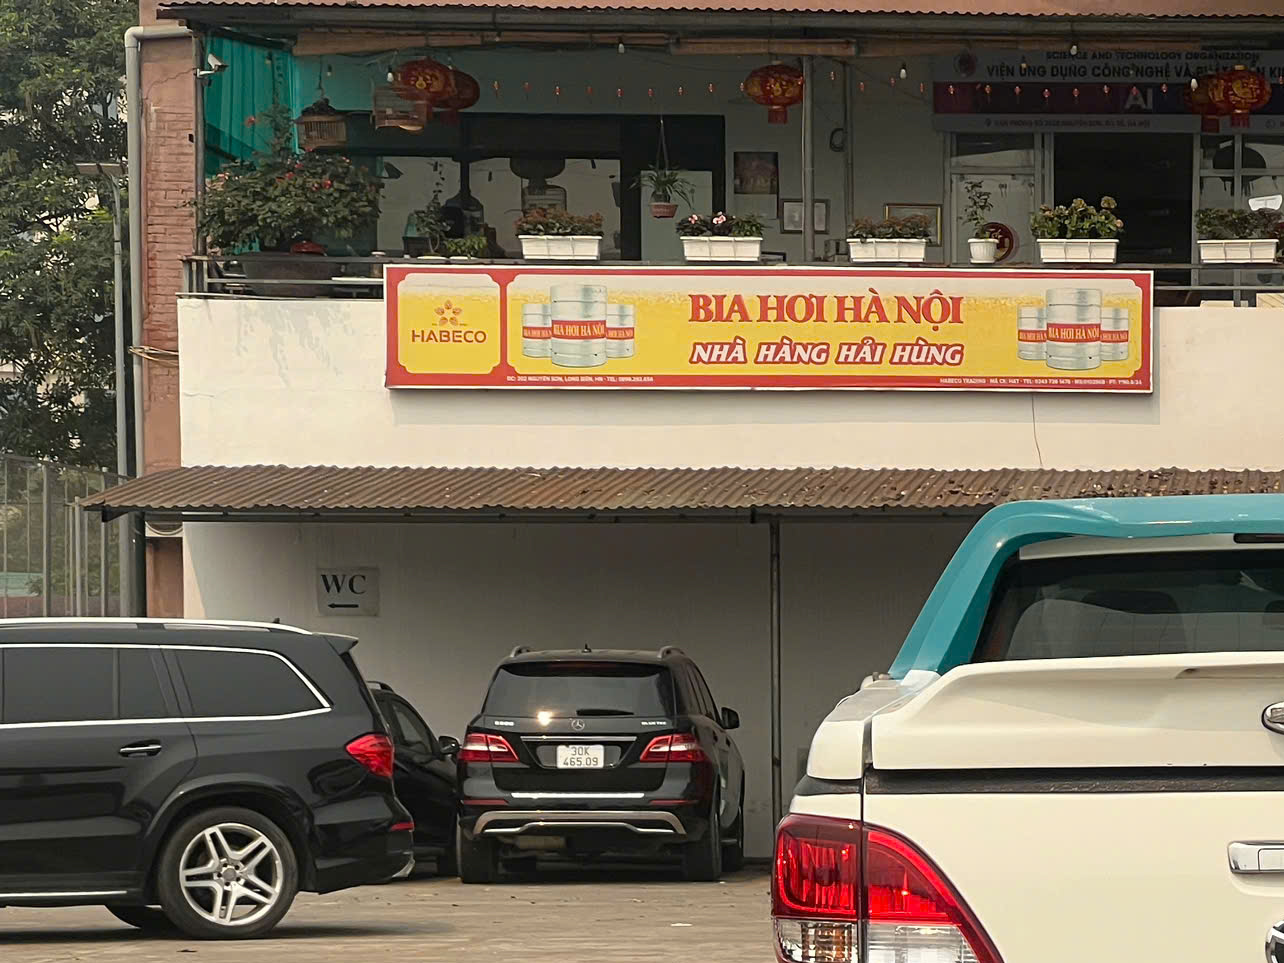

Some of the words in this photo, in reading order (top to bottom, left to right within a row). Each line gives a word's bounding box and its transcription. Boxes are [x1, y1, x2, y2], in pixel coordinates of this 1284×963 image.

[987, 62, 1015, 80] VIỆN
[1051, 65, 1086, 80] DỤNG
[1092, 62, 1134, 77] CÔNG
[1175, 61, 1192, 77] VÀ
[1125, 87, 1152, 110] AI
[688, 294, 752, 322] BIA
[757, 293, 828, 322] HƠI
[834, 288, 890, 323] HÀ
[894, 288, 964, 332] NỘI
[411, 329, 487, 344] HABECO
[690, 336, 747, 364] NHÀ
[755, 336, 830, 364] HÀNG
[836, 336, 886, 364] HẢI
[890, 337, 964, 365] HÙNG
[320, 574, 367, 595] WC
[562, 757, 599, 766] 465.09
[571, 747, 590, 756] 30K
